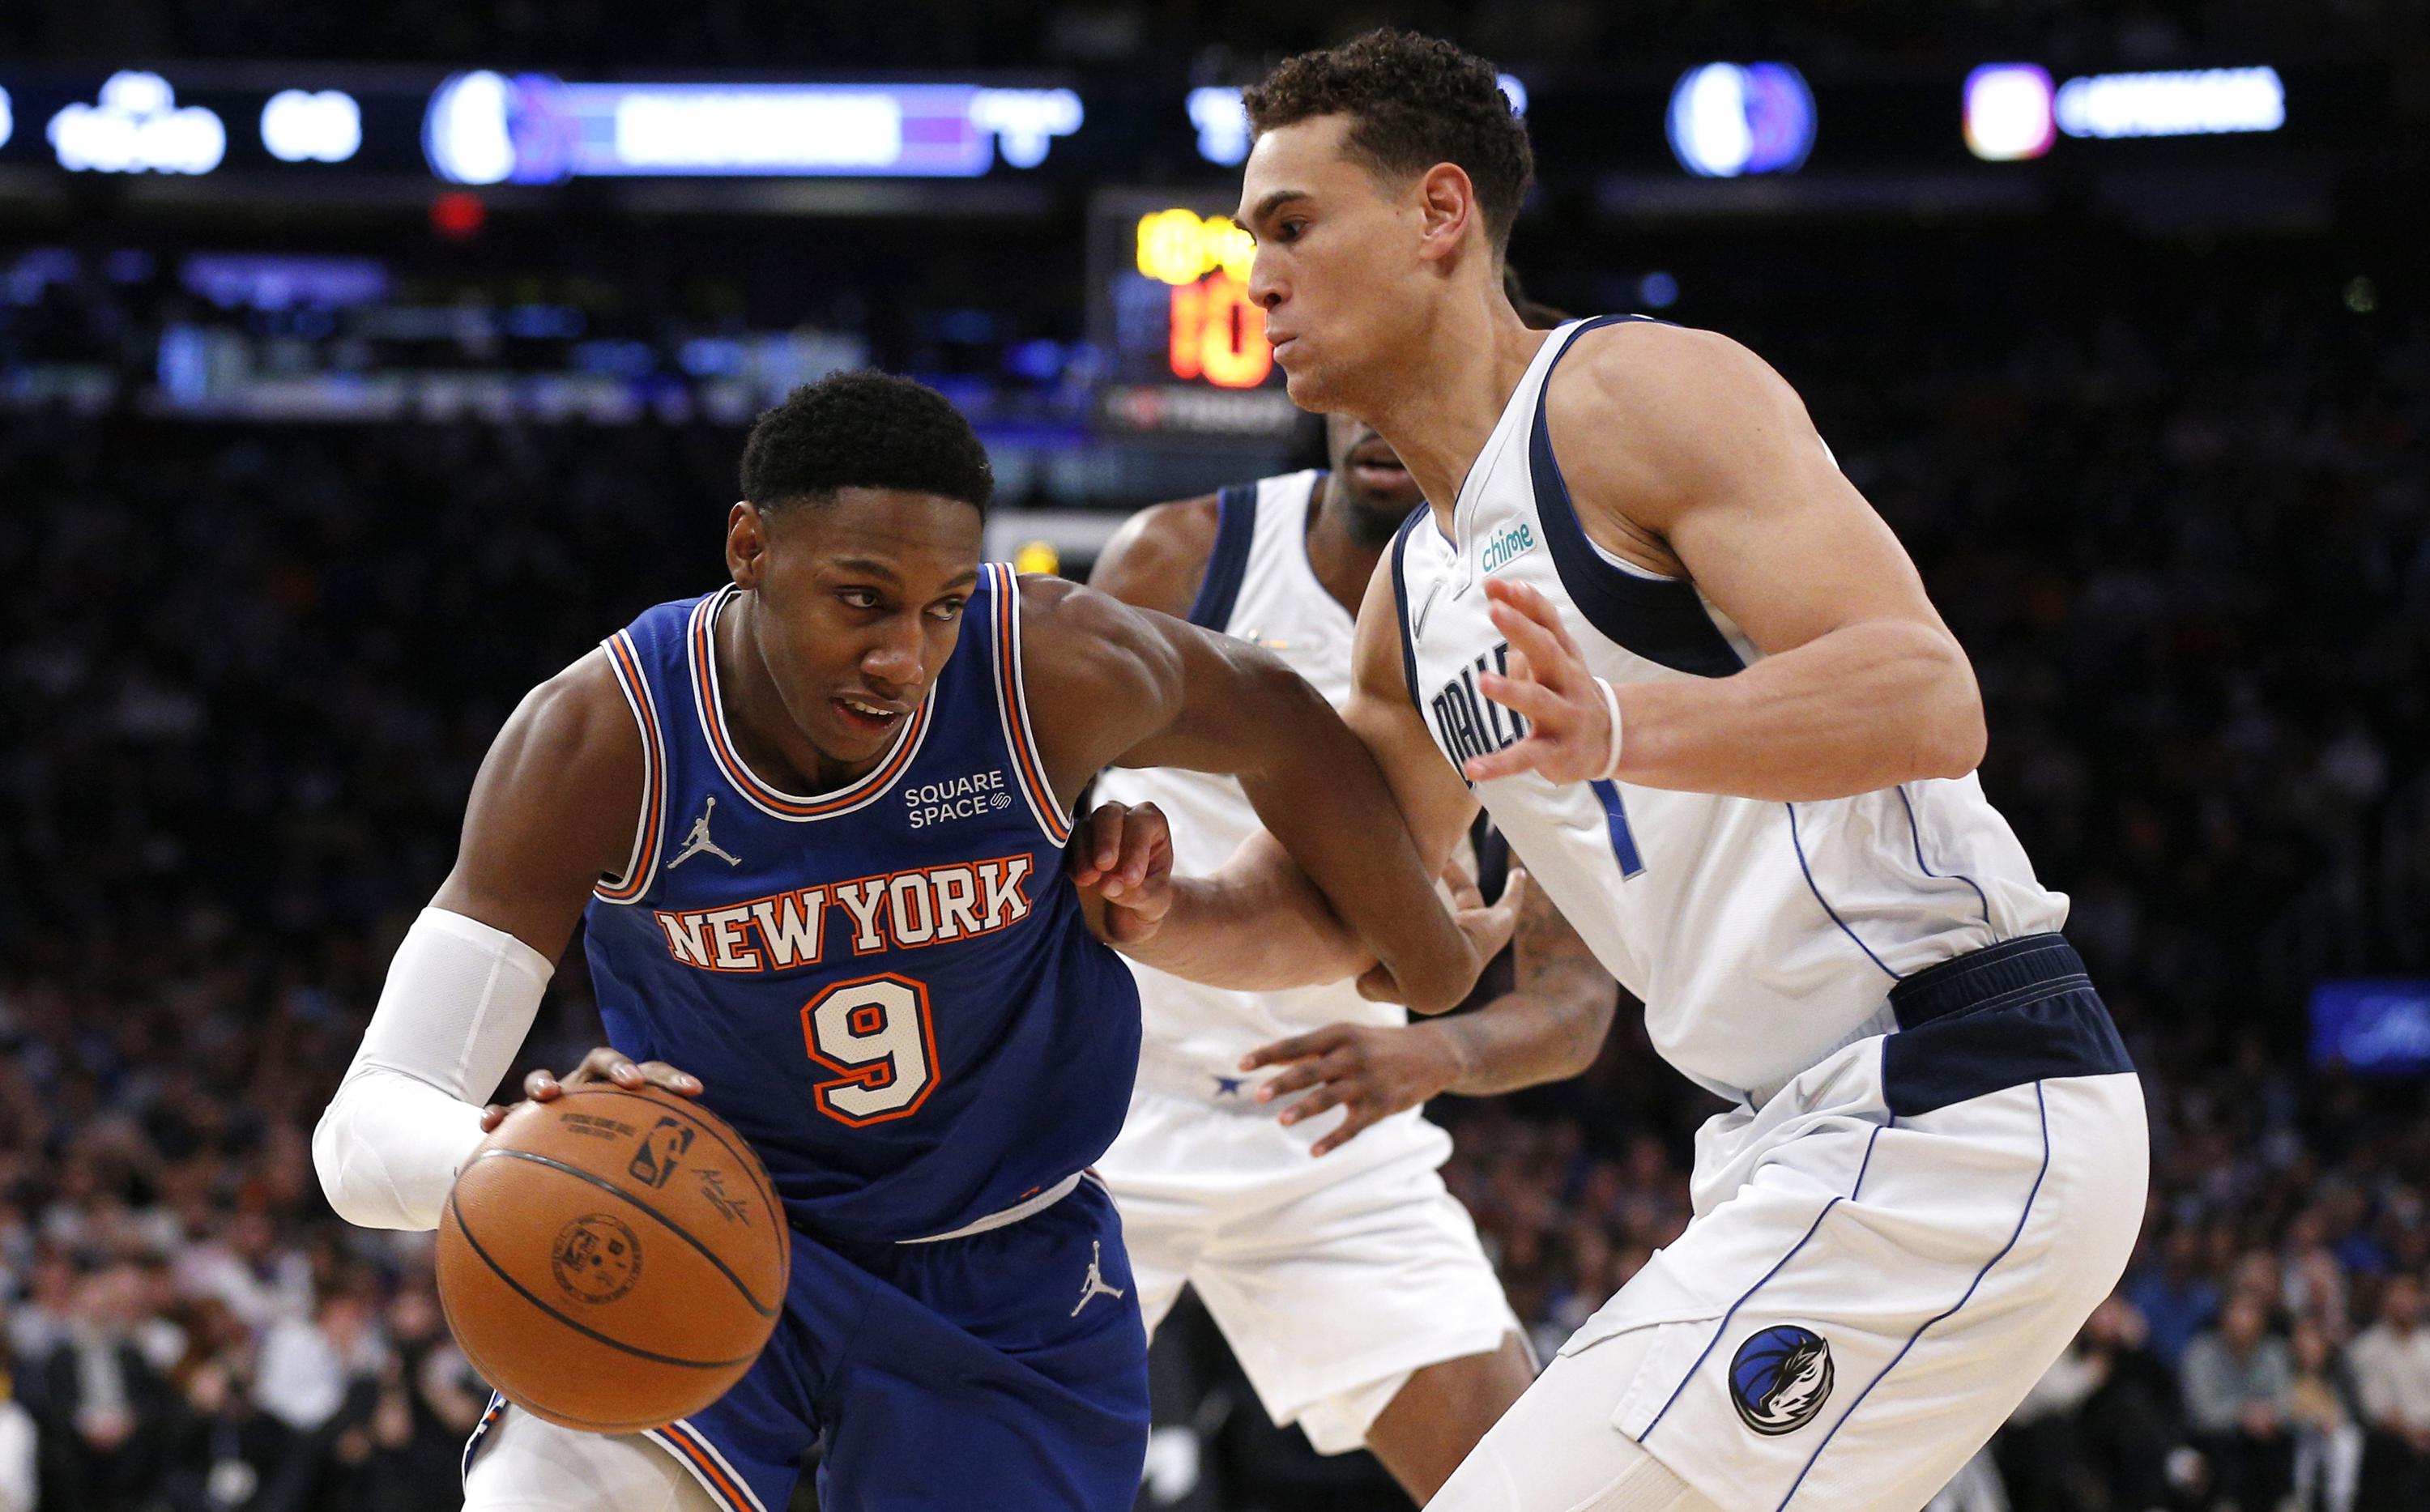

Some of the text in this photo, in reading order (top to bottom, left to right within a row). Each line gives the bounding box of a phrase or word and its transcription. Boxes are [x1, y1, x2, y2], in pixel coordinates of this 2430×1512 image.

[1482, 523, 1533, 573] chime
[905, 770, 1004, 807] SQUARE
[909, 795, 988, 828] SPACE
[654, 854, 1033, 972] NEW YORK
[800, 972, 940, 1128] 9
